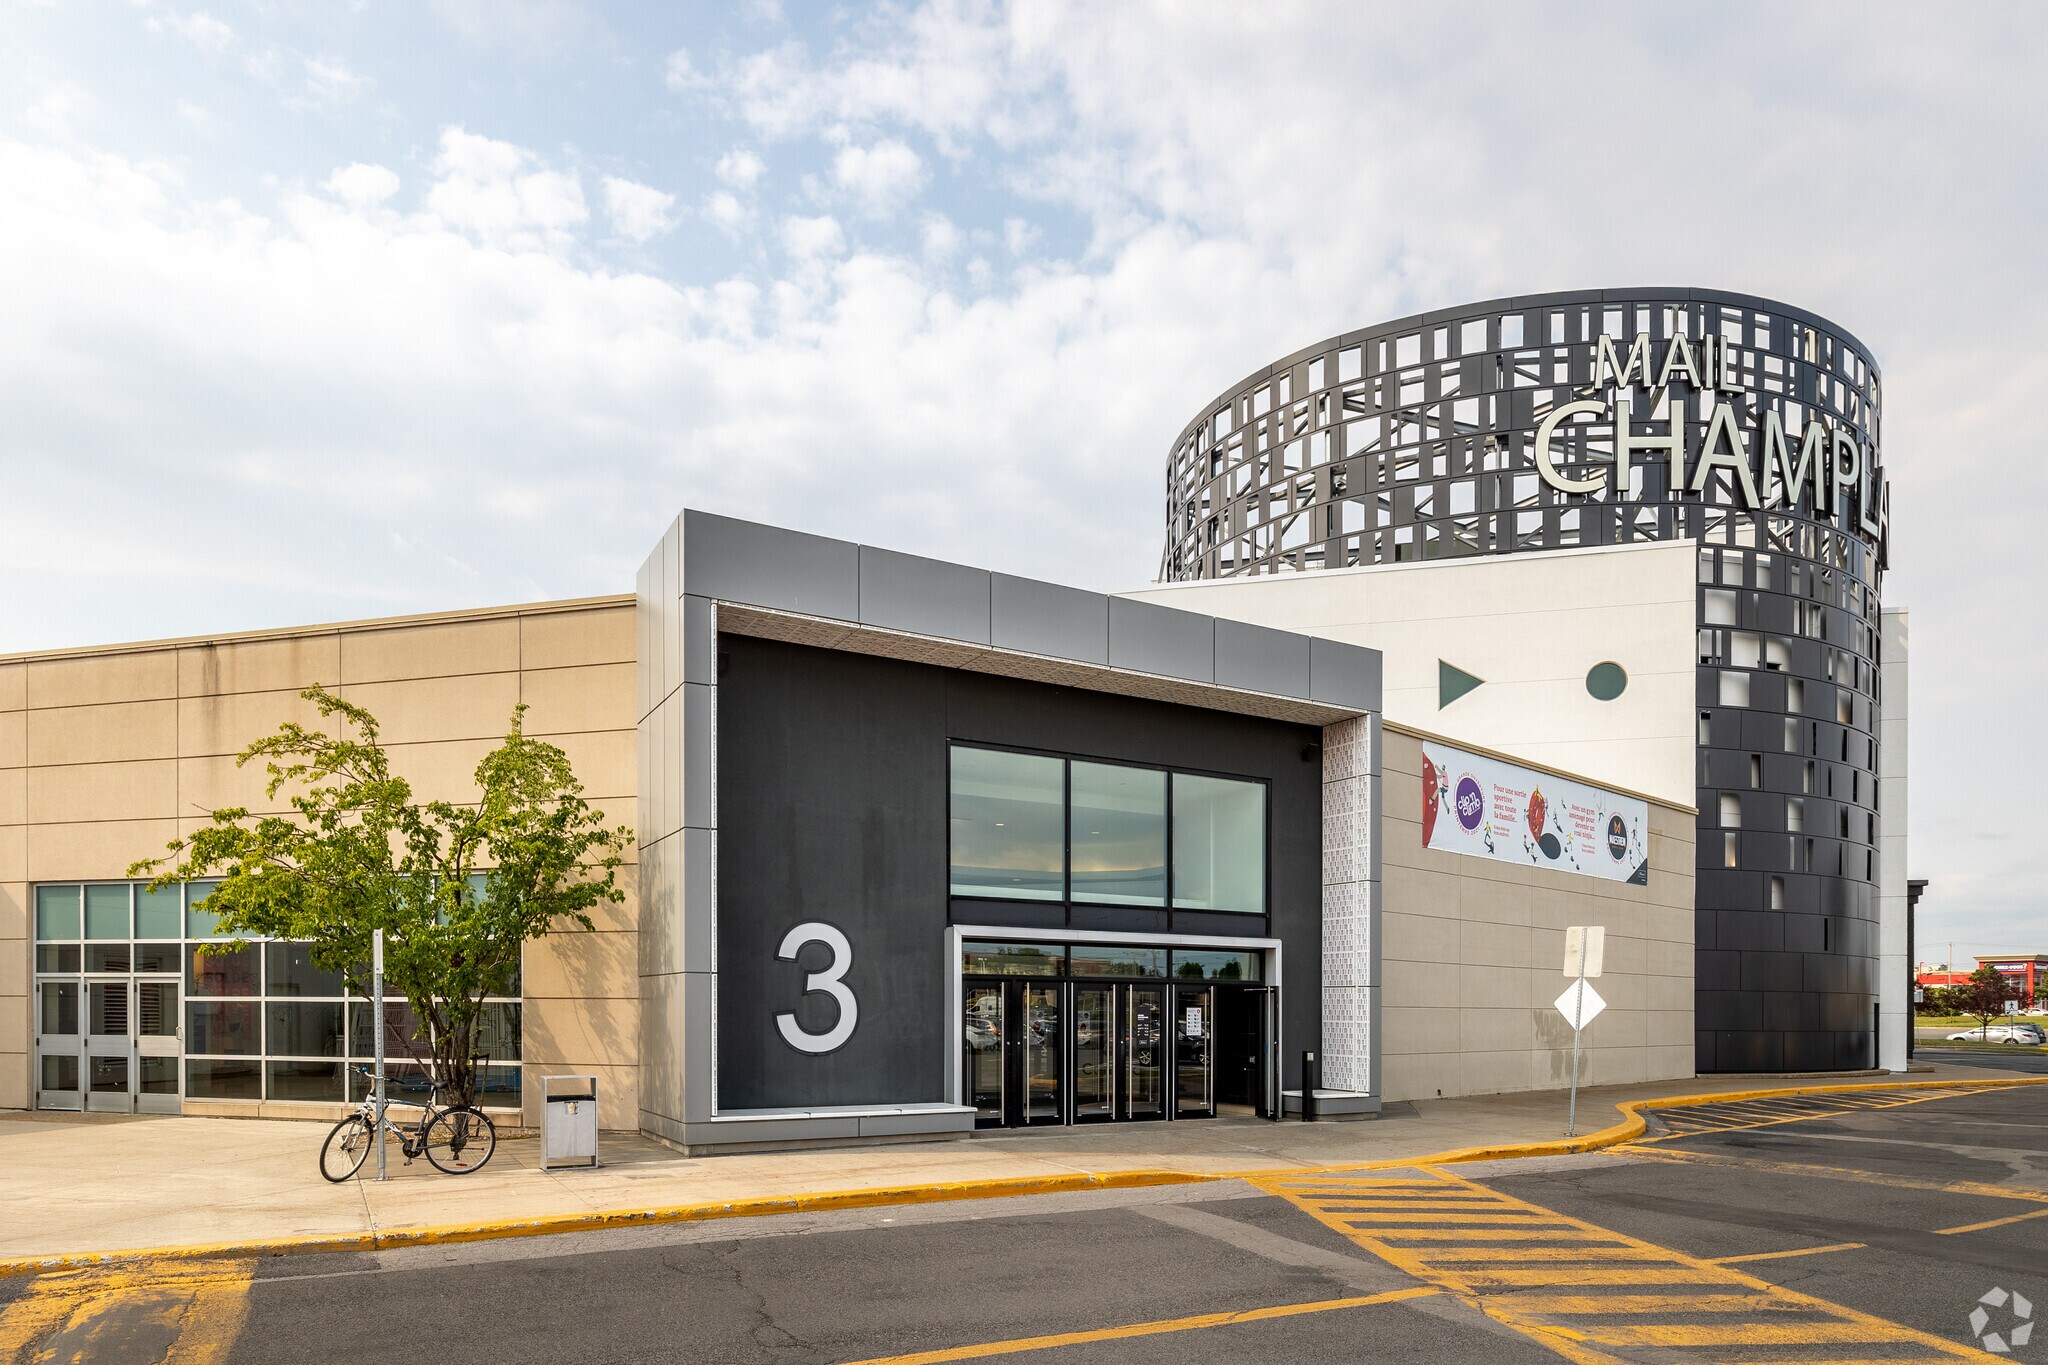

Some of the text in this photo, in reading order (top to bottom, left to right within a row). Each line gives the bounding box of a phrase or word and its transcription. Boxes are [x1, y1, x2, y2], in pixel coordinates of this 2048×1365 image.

[1594, 332, 1745, 394] MAIL
[1494, 784, 1504, 792] Pour
[1514, 790, 1527, 798] sortie
[1494, 794, 1513, 804] sportive
[1505, 805, 1516, 813] toute
[1575, 821, 1589, 830] devenir
[776, 922, 858, 1053] 3
